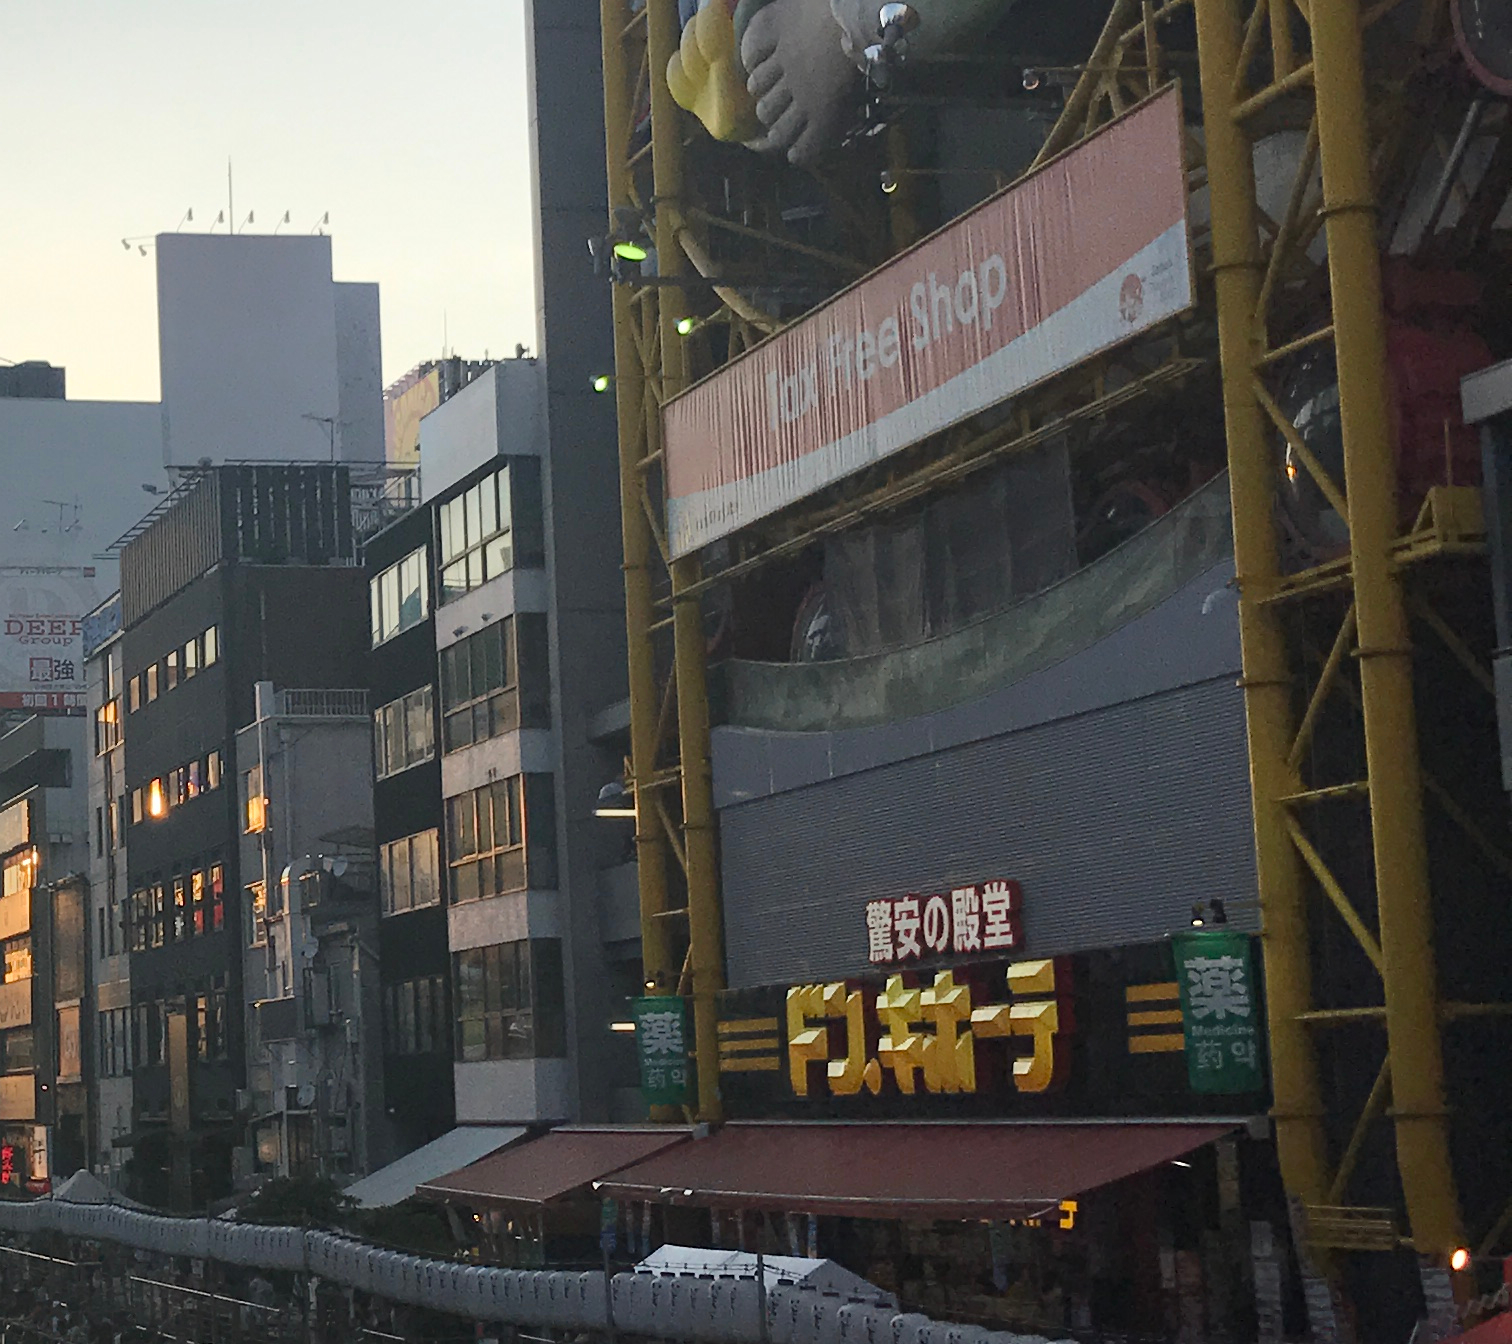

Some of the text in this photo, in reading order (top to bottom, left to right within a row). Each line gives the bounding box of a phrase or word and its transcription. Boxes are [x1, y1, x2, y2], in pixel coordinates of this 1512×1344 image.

[909, 254, 1007, 351] Shop
[18, 635, 73, 647] Group
[865, 881, 1013, 962] 驚安の殿堂
[1183, 956, 1251, 1020] 薬
[639, 1011, 683, 1054] 薬
[1191, 1025, 1256, 1037] Medicine
